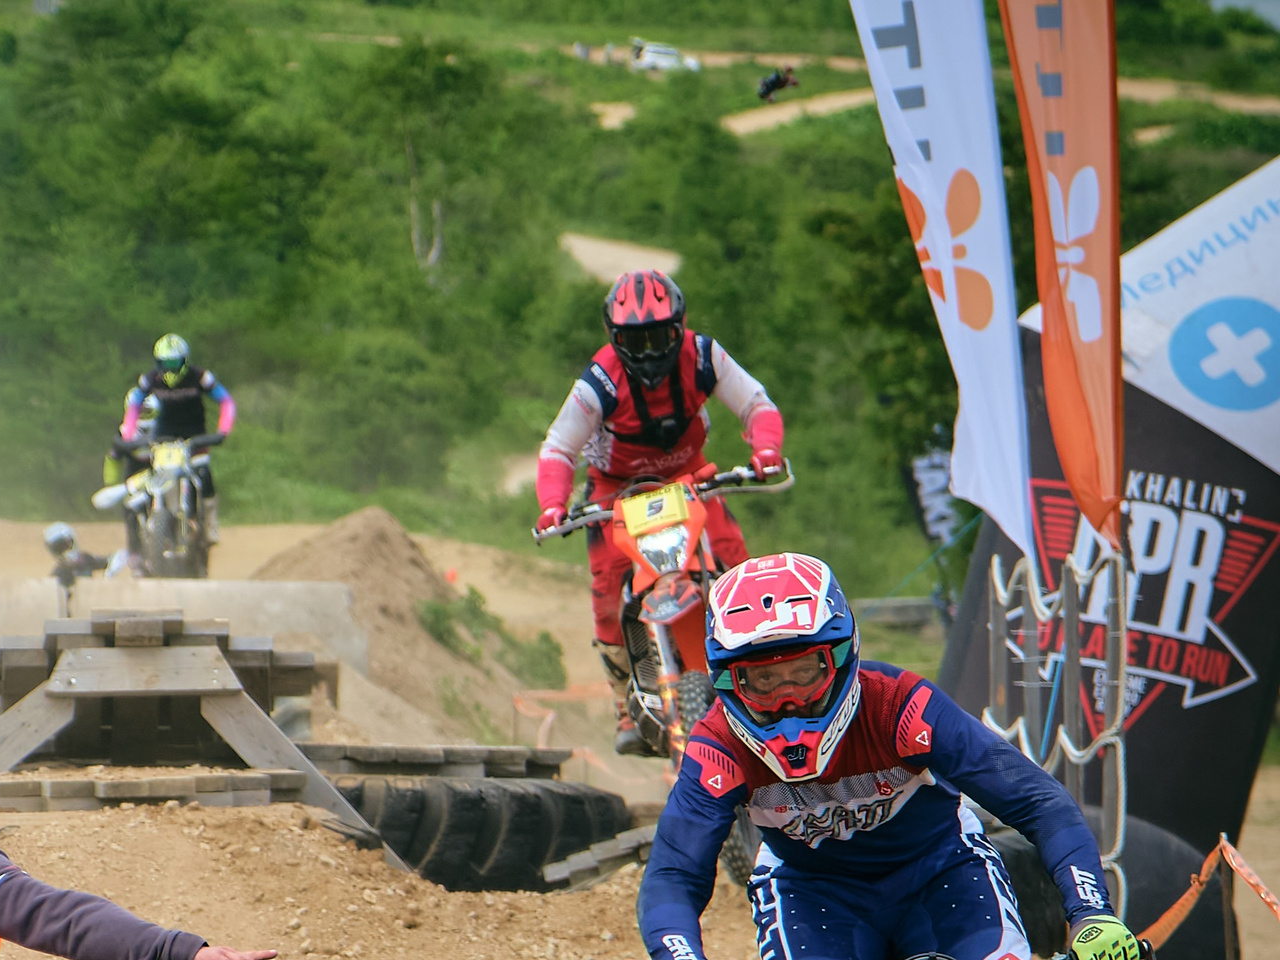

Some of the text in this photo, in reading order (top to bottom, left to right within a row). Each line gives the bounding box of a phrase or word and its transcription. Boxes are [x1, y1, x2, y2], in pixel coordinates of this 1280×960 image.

[646, 498, 665, 518] 5
[1124, 470, 1235, 518] KHALIN
[1181, 641, 1231, 687] RUN
